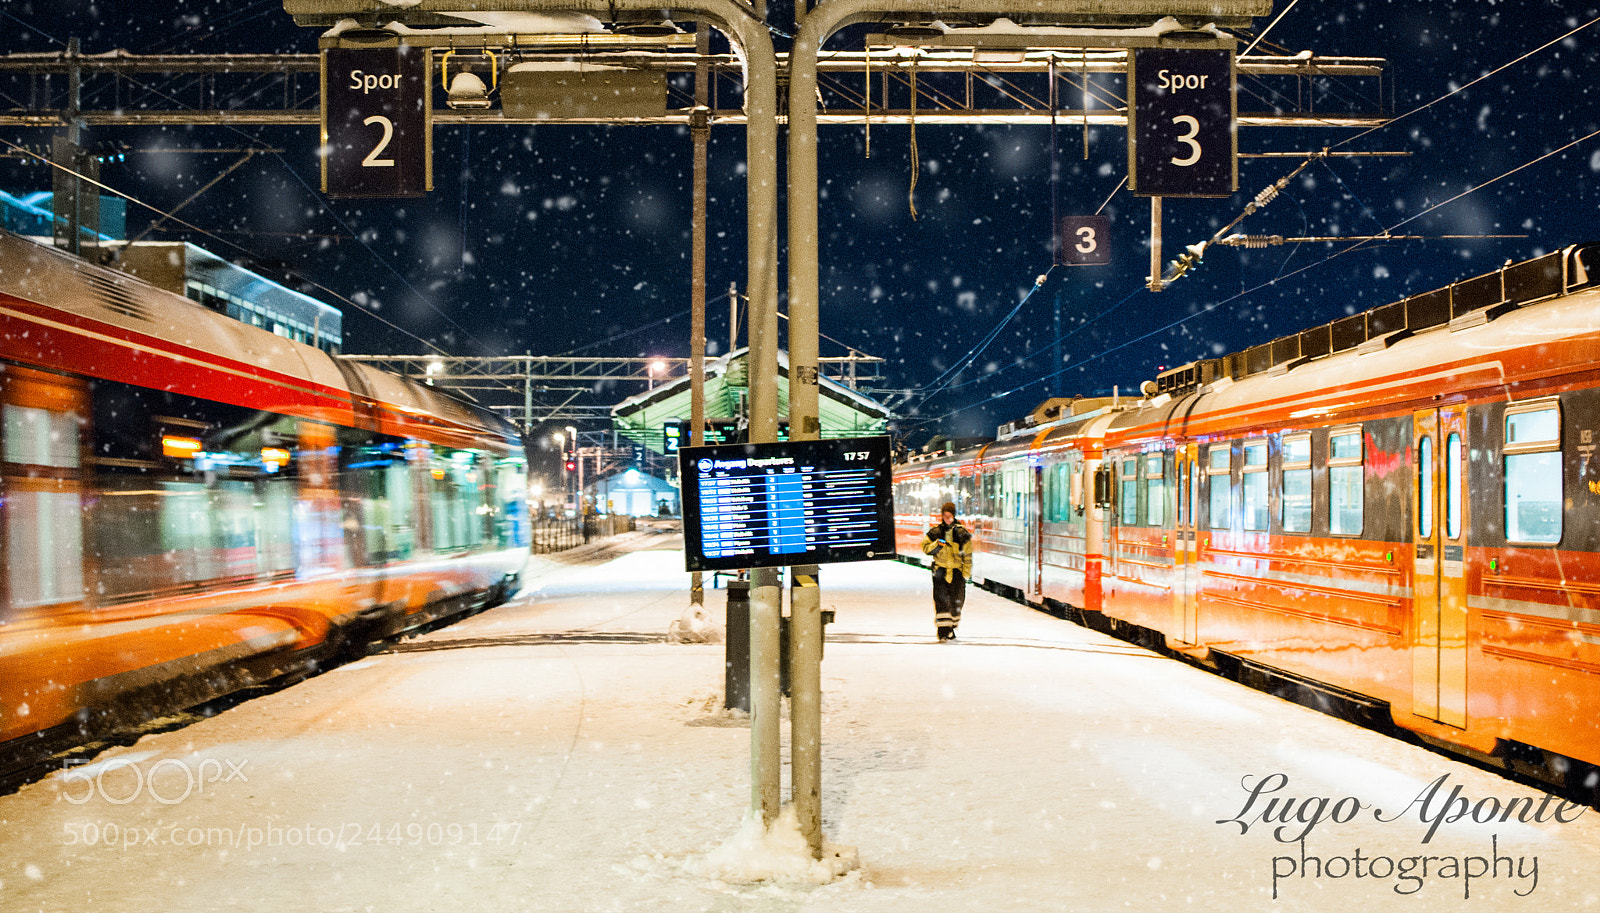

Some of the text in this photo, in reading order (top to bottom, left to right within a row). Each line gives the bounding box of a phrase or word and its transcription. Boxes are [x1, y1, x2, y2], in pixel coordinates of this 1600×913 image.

[350, 69, 402, 95] Spor
[1158, 69, 1208, 94] Spor
[361, 115, 395, 167] 2
[1170, 114, 1202, 167] 3
[1075, 226, 1097, 254] 3
[667, 437, 679, 451] 2
